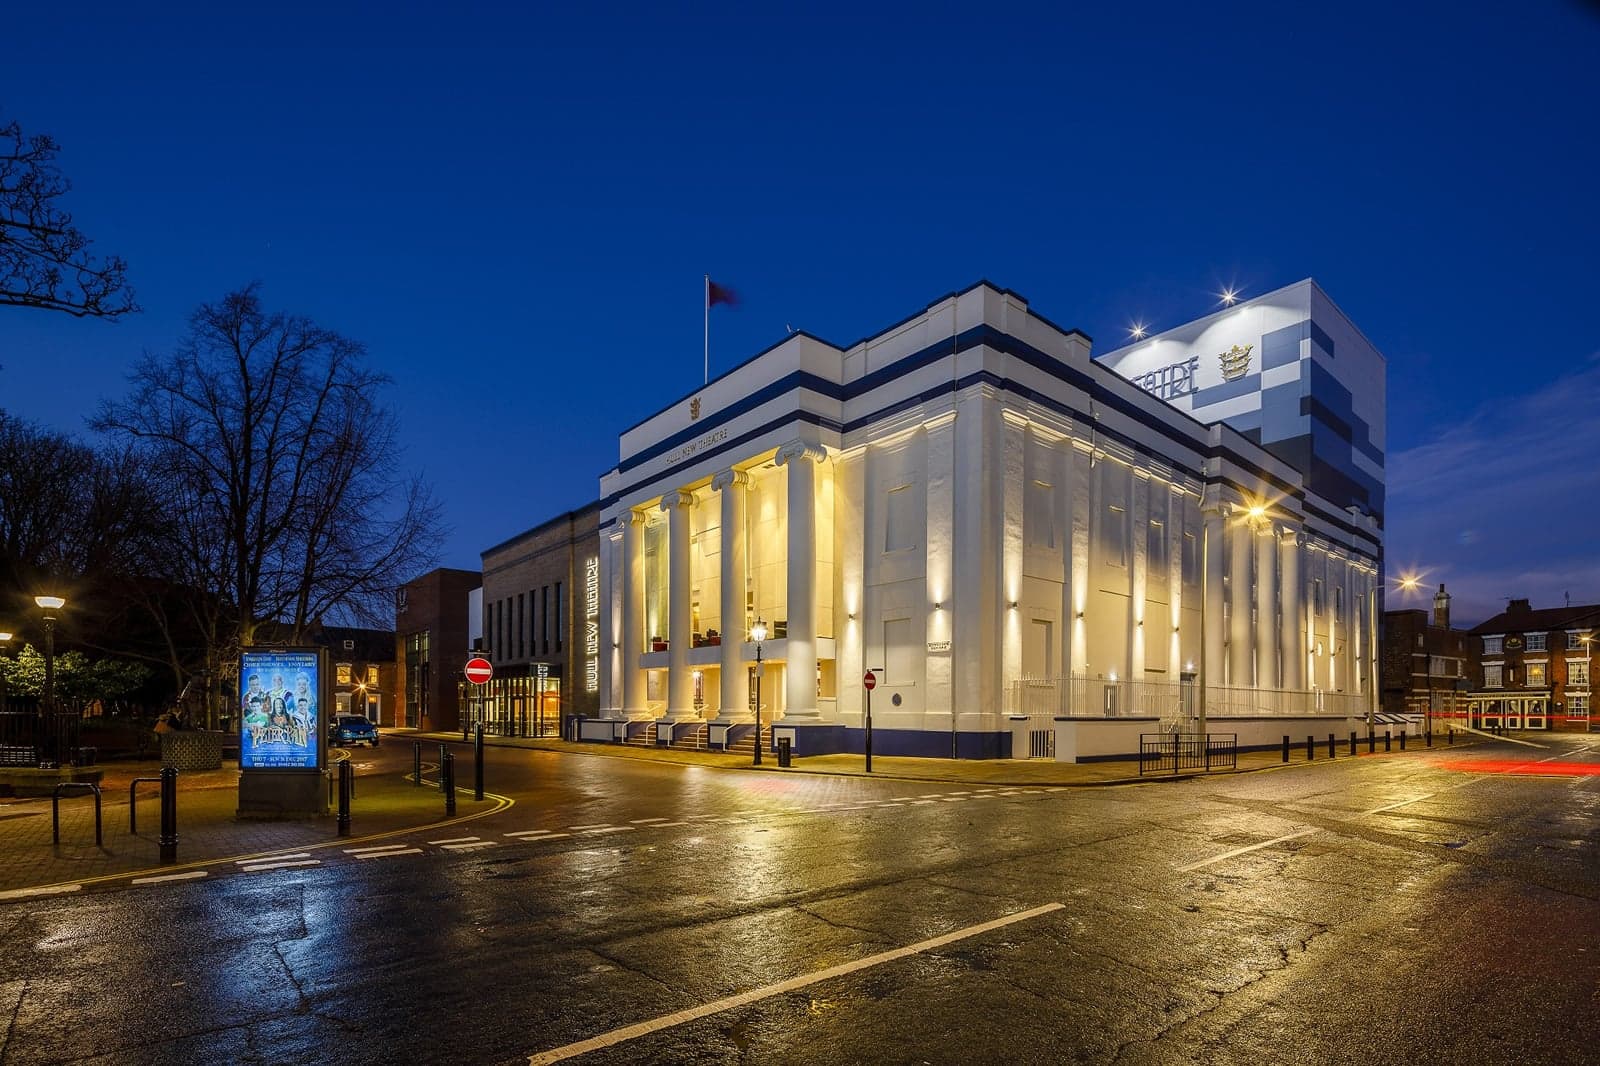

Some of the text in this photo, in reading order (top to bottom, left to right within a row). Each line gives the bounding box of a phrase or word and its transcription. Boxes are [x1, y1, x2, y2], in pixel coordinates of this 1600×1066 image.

[699, 428, 728, 449] THEATRE
[586, 556, 599, 693] HULL NEW THEATRE
[252, 725, 307, 748] PETER PAN
